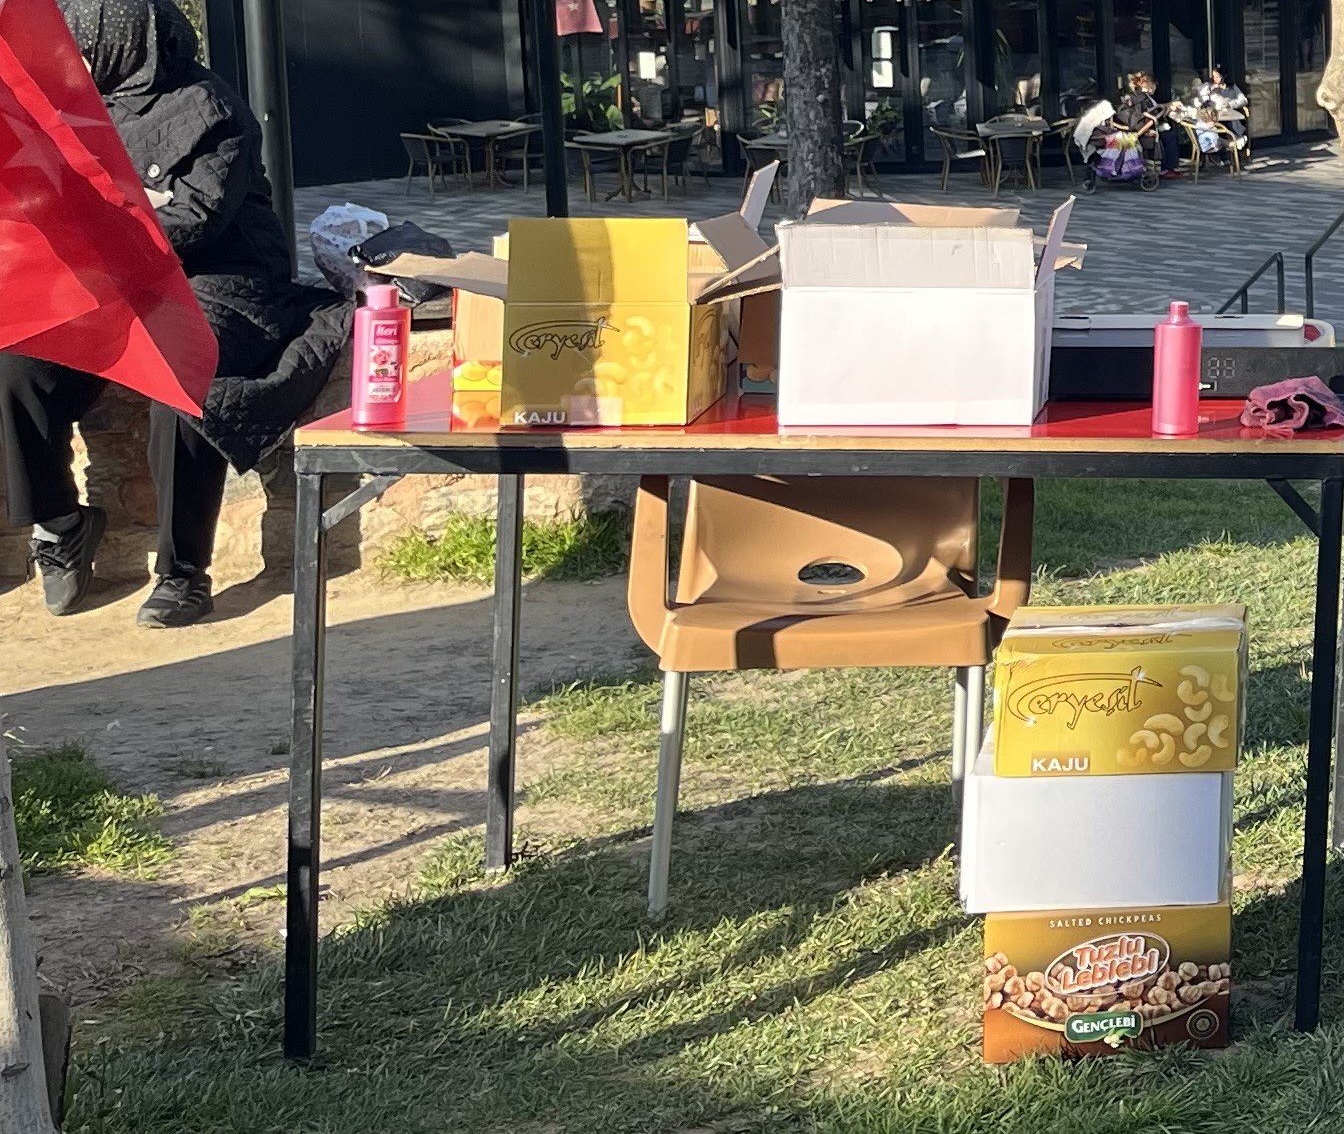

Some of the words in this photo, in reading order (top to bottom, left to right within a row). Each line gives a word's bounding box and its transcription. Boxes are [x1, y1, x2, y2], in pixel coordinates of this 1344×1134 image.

[514, 411, 566, 424] KAJU
[1032, 756, 1089, 772] KAJU
[1049, 918, 1092, 928] SALTED
[1098, 913, 1162, 925] CHICKPEAS
[1074, 936, 1145, 968] Tuzlu
